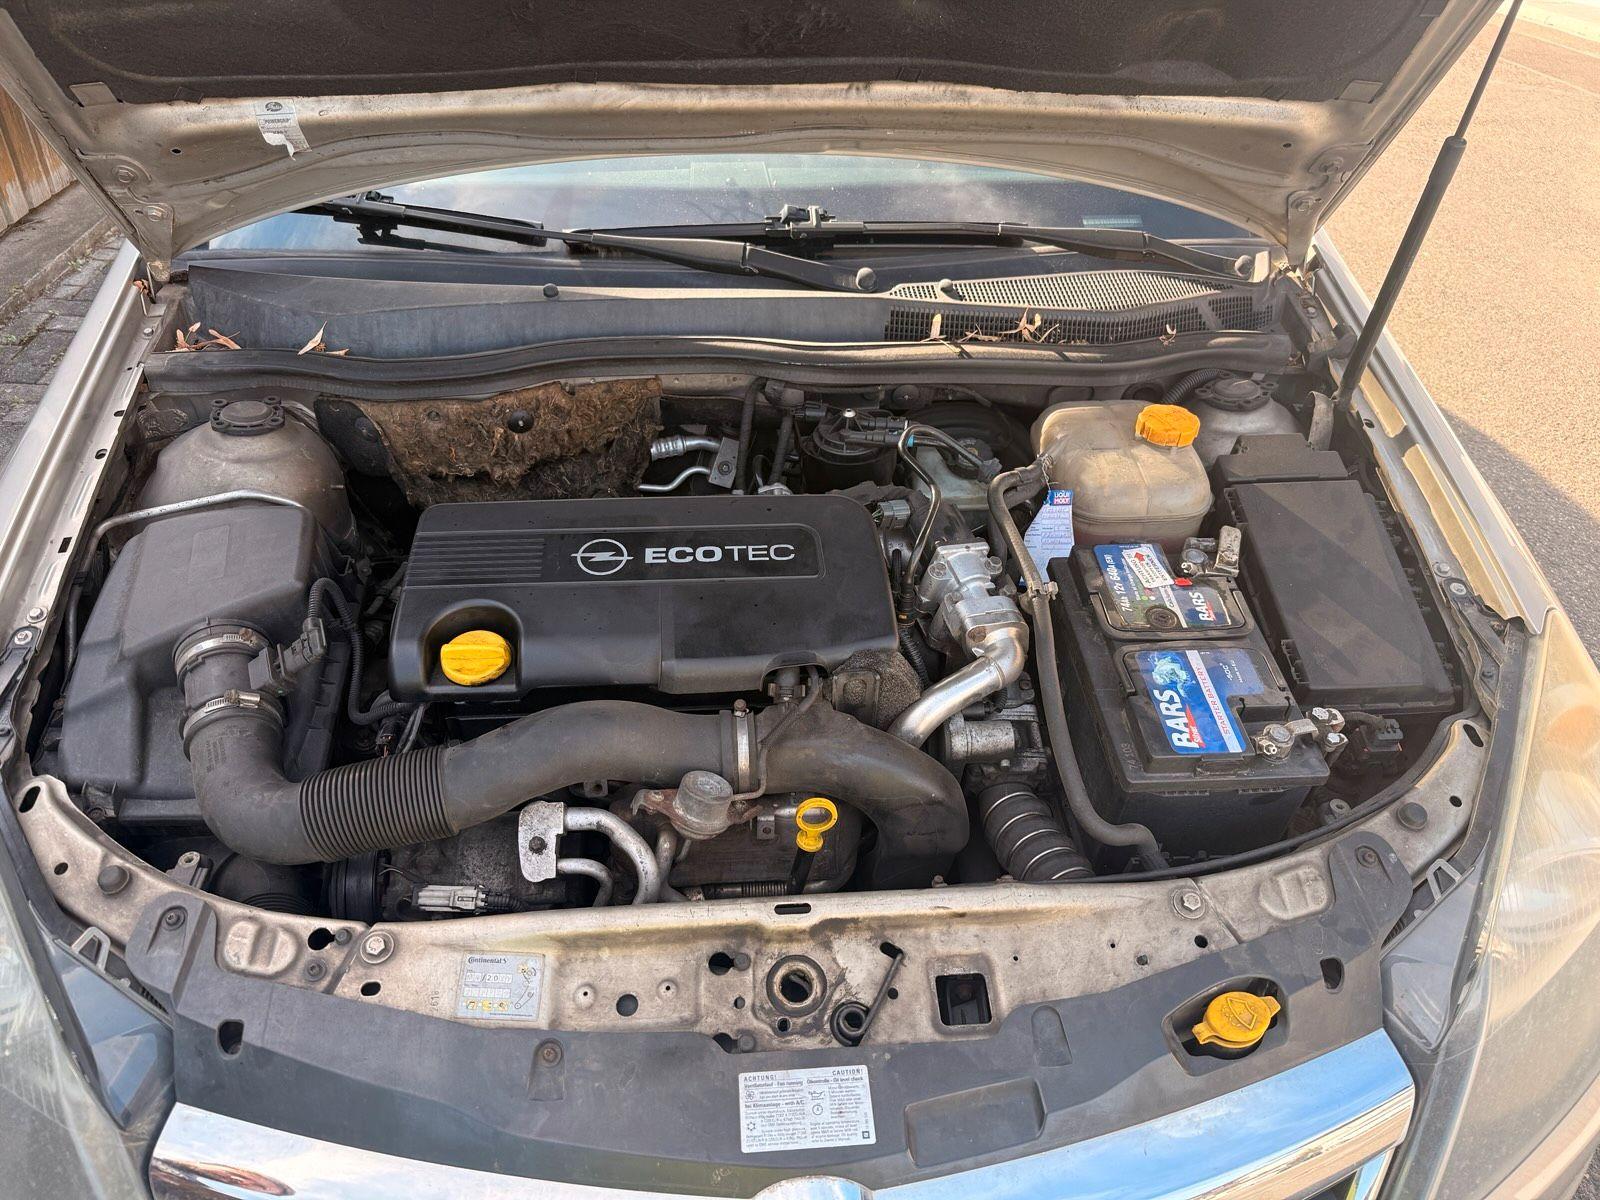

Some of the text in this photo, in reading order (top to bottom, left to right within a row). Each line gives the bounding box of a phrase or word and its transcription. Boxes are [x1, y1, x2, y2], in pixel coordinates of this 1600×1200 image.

[644, 544, 796, 564] ECOTEC
[1188, 591, 1214, 622] BARS
[1195, 665, 1215, 700] BATTERY
[1153, 690, 1200, 749] BARS
[1210, 700, 1231, 736] STARTER
[468, 956, 502, 964] Continental
[743, 1074, 777, 1082] ACHTUNG!
[832, 1068, 863, 1076] CAUTION!
